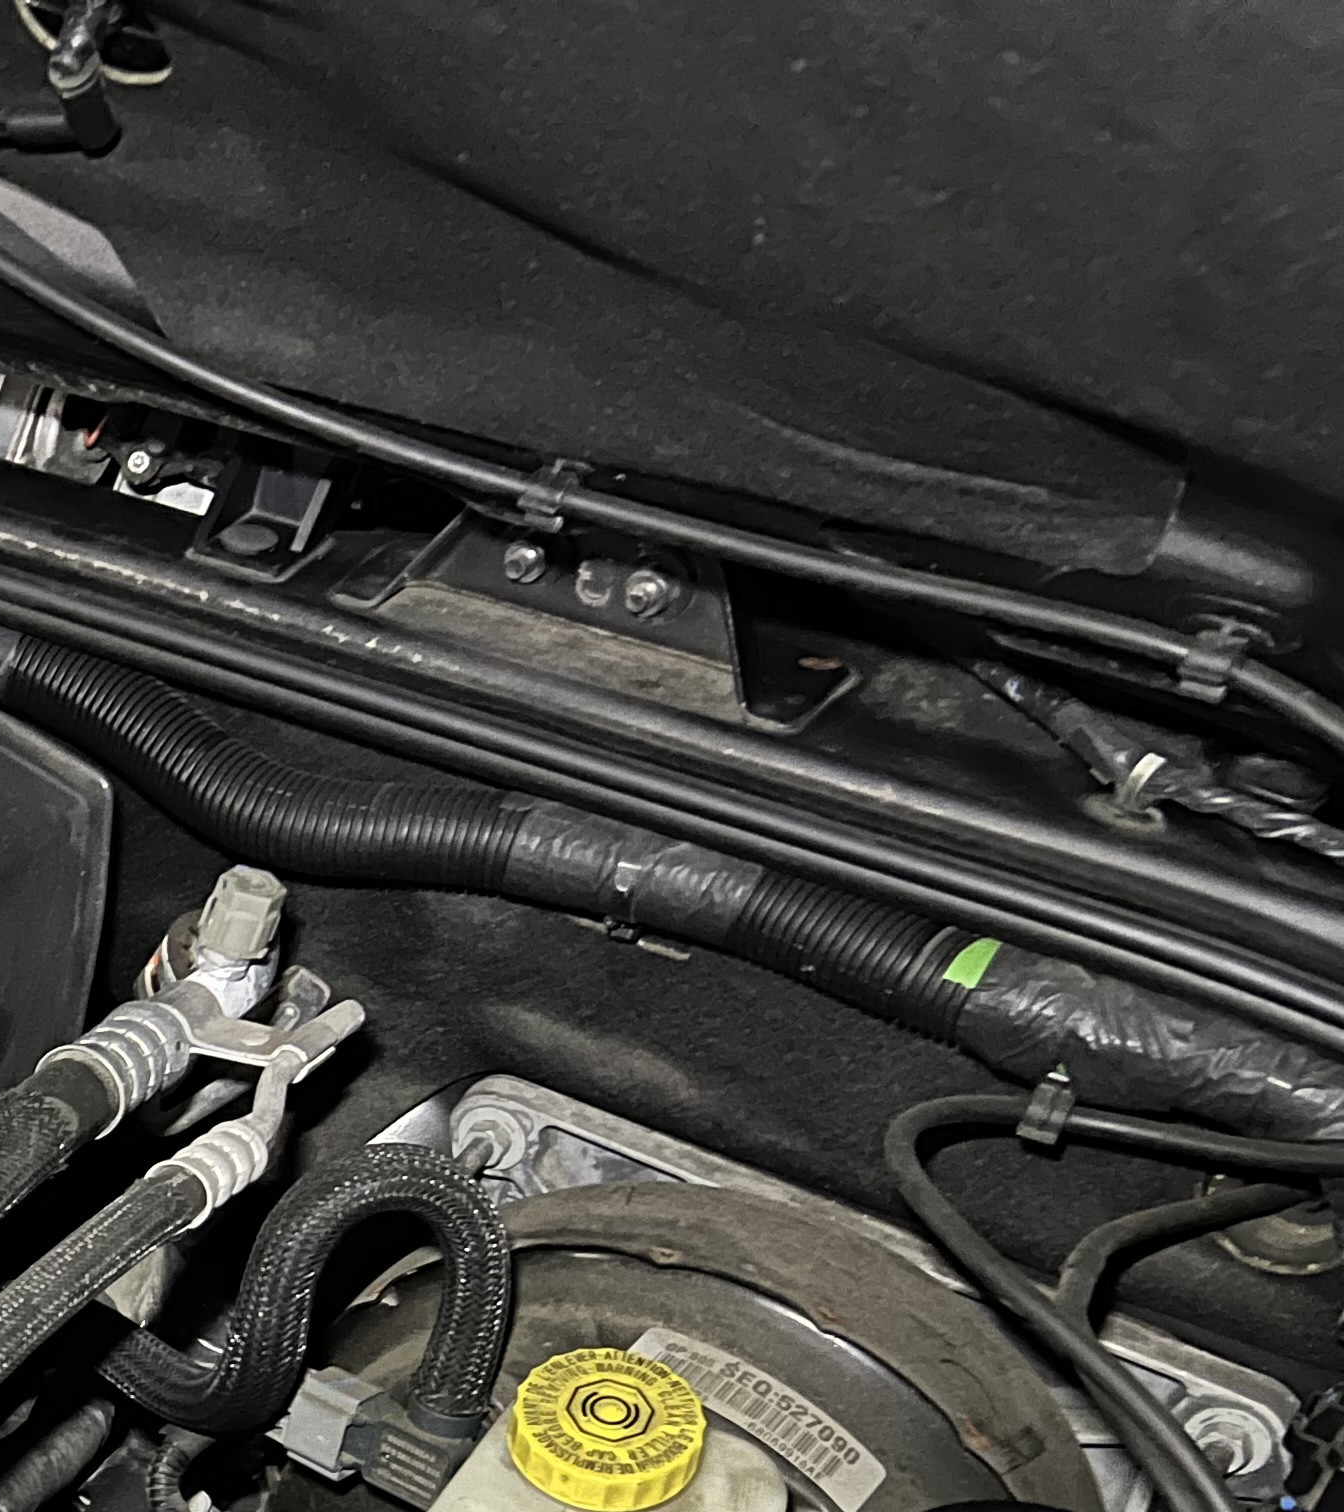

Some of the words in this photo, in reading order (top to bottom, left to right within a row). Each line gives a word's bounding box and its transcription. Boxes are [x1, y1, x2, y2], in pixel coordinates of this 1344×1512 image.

[595, 1362, 659, 1387] WARNING
[585, 1448, 617, 1460] CAP
[628, 1430, 675, 1461] FILLER
